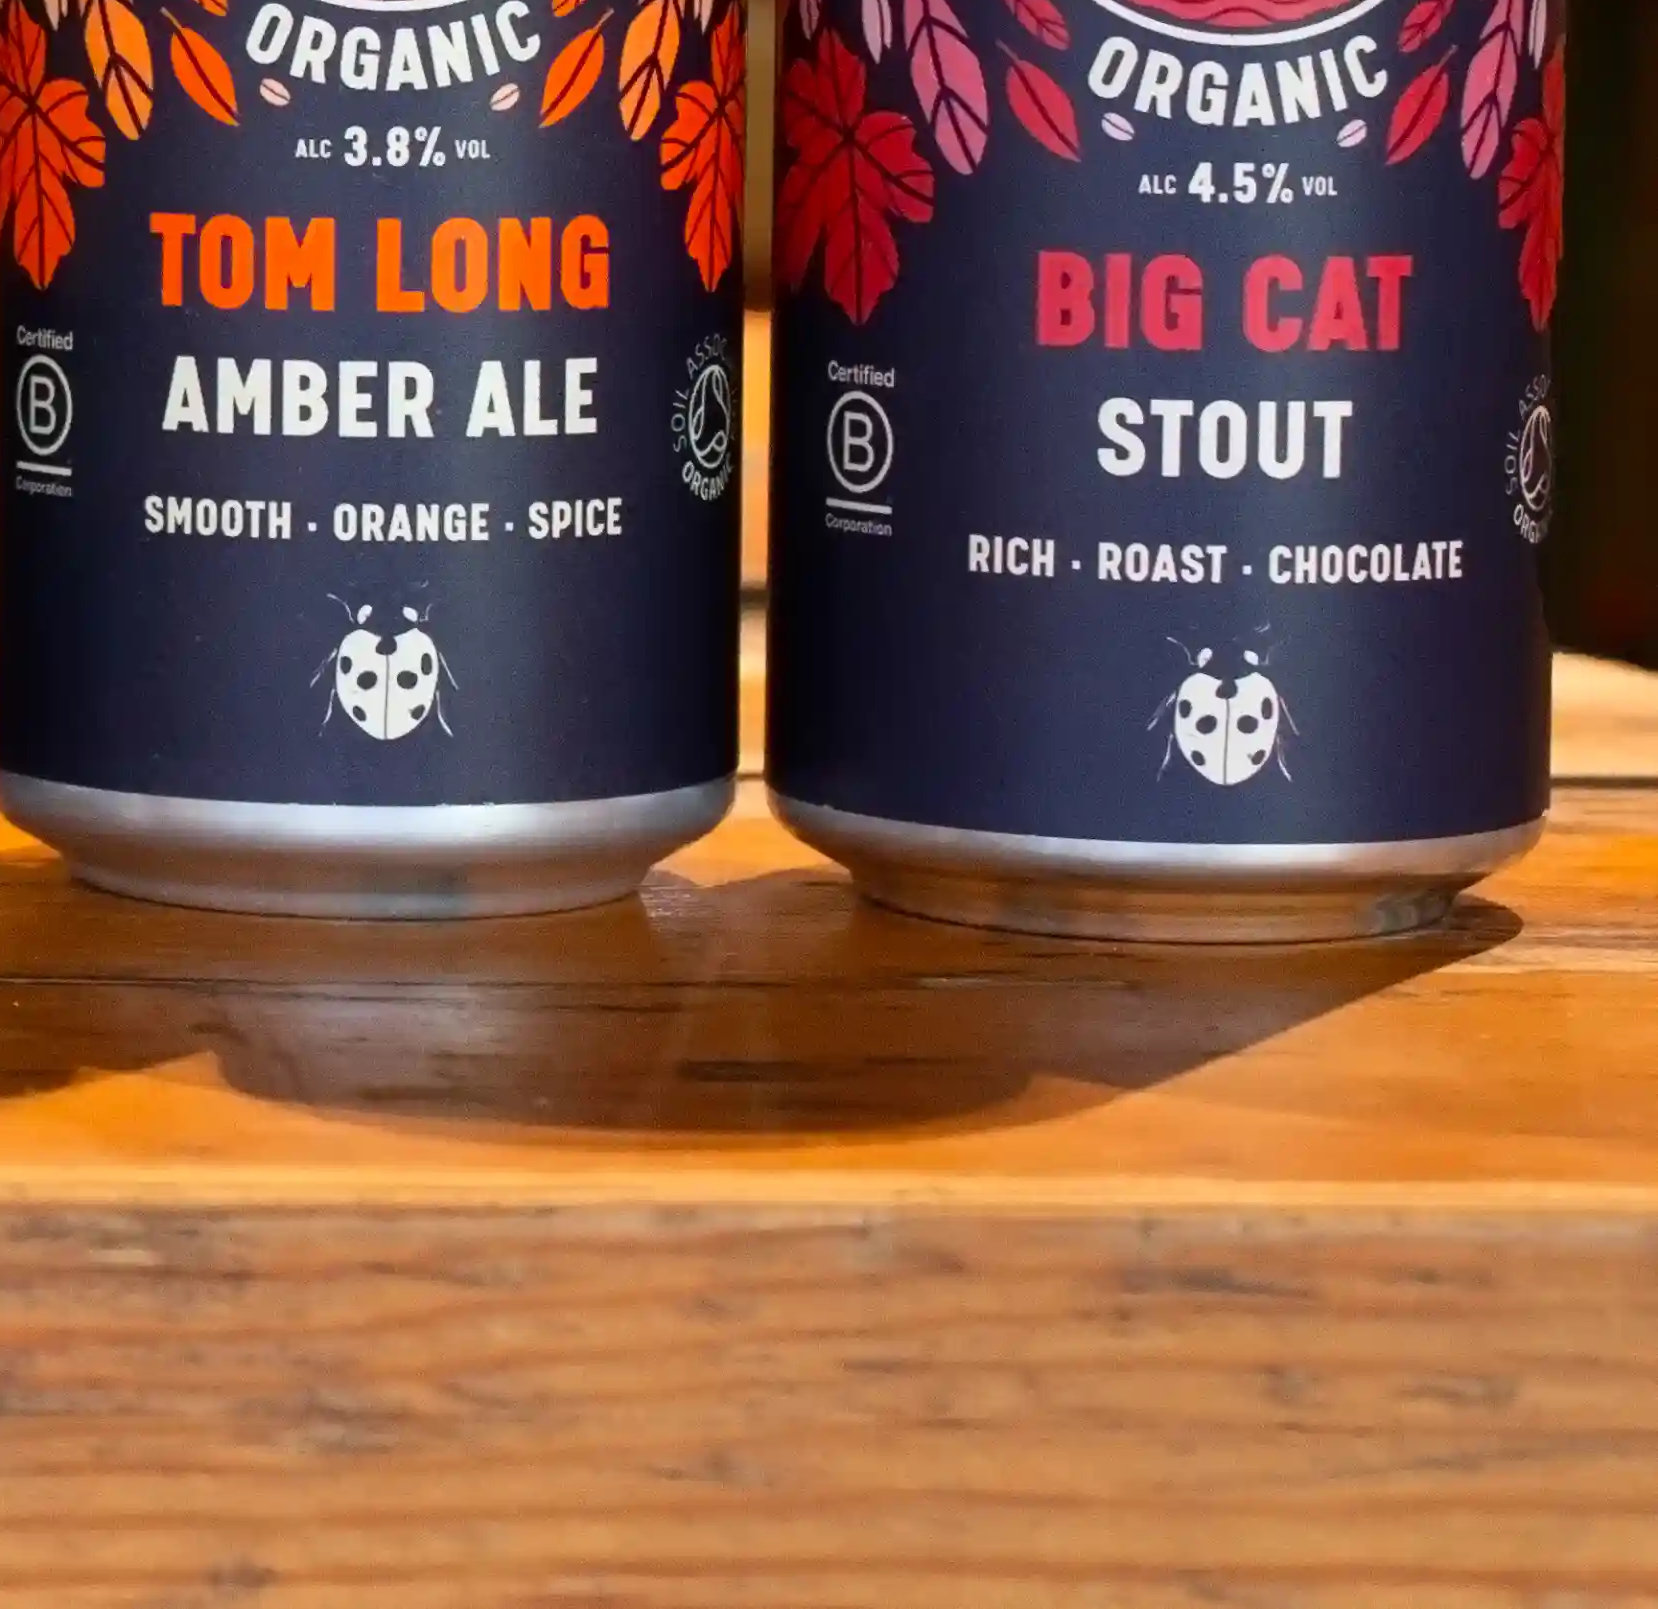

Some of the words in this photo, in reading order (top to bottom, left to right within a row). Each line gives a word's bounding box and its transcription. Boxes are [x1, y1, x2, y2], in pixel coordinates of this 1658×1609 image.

[245, 0, 541, 92] ORGANIC
[1087, 34, 1388, 127] ORGANIC
[294, 138, 332, 159] ALC
[343, 125, 446, 167] 3.8%
[454, 139, 491, 160] VOL
[1138, 174, 1177, 195] ALC
[1188, 161, 1294, 204] 4.5%
[1301, 175, 1338, 197] VOL
[149, 212, 336, 312] TOM
[375, 214, 610, 314] LONG
[1037, 251, 1203, 351] BIG
[1242, 253, 1412, 353] CAT
[16, 325, 73, 351] Certified
[162, 355, 435, 438] AMBER
[465, 357, 598, 438] ALE
[827, 360, 896, 388] Certified
[671, 389, 690, 452] SOIL
[1097, 397, 1353, 480] STOUT
[1504, 430, 1521, 495] SOIL
[144, 495, 292, 540] SMOOTH
[333, 502, 490, 542] ORANGE
[528, 497, 622, 540] SPICE
[825, 512, 892, 537] Corporation
[968, 533, 1055, 578] RICH
[1098, 541, 1228, 584] ROAST
[1268, 540, 1464, 585] CHOCOLATE
